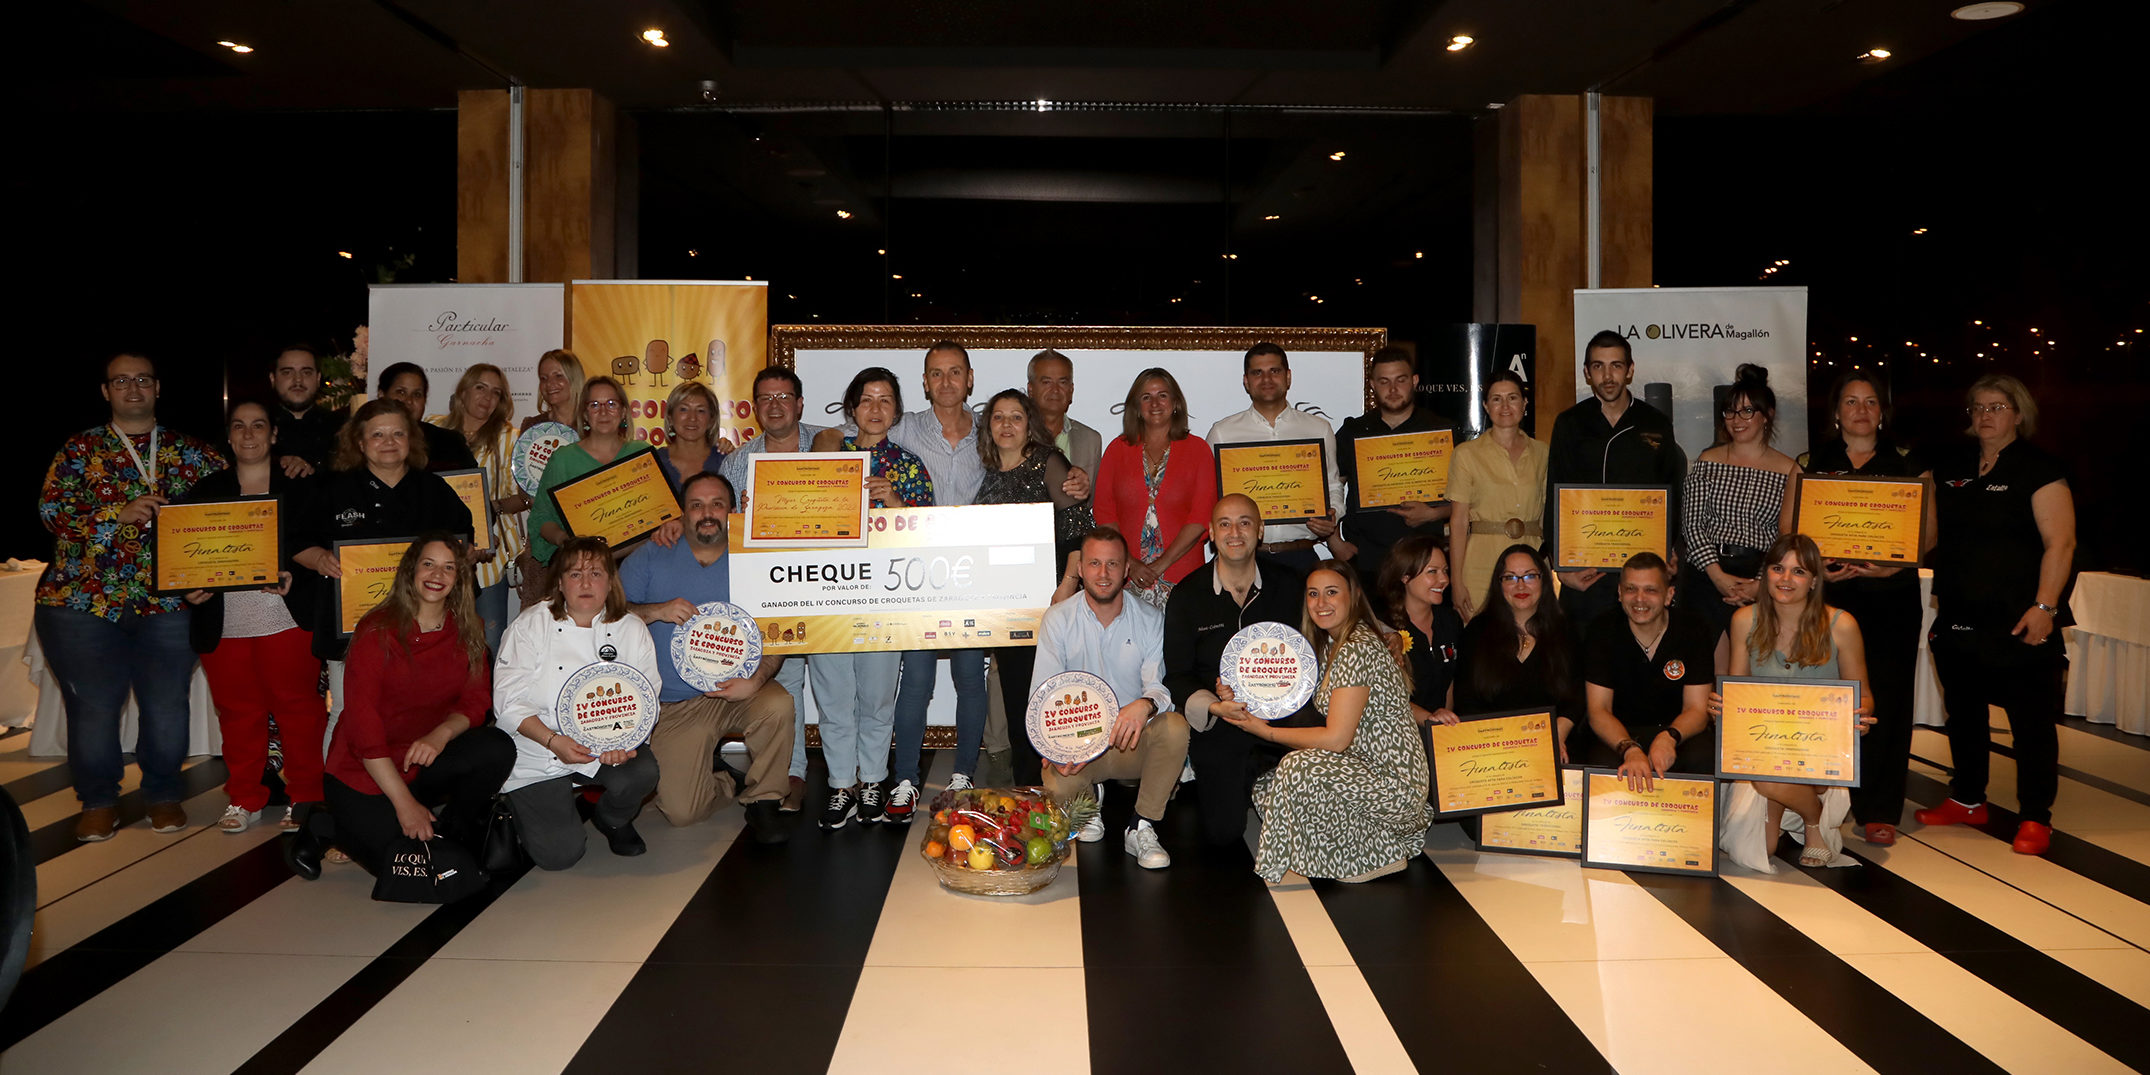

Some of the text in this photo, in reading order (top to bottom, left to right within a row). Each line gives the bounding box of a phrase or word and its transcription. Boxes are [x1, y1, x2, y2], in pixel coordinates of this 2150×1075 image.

[428, 311, 510, 332] Particular
[1618, 324, 1640, 340] LA
[1645, 323, 1725, 340] OLIVERA
[1725, 329, 1770, 340] Magallón
[436, 334, 495, 350] Garnacha
[1425, 384, 1444, 394] QUE
[1447, 384, 1468, 392] VES,
[1376, 466, 1436, 481] Finalista
[1243, 479, 1302, 494] Finalista
[335, 512, 365, 520] FLASH
[590, 494, 649, 523] Finalista
[894, 515, 918, 532] DE
[1823, 515, 1893, 530] Finalista
[1581, 523, 1645, 539] Finalista
[183, 541, 255, 558] Finalista
[769, 563, 872, 584] CHEQUE
[884, 554, 974, 591] 500€
[825, 598, 867, 606] CONCURSO
[880, 596, 925, 604] CROQUETAS
[691, 630, 744, 646] IV CONCURSO
[701, 641, 744, 655] CROQUETAS
[576, 695, 634, 711] IV CONCURSO
[1045, 703, 1099, 719] IV CONCURSO
[577, 703, 637, 720] DE CROQUETAS
[1045, 711, 1102, 727] DE CROQUETAS
[1748, 724, 1824, 742] Finalista
[1459, 759, 1529, 777] Finalista
[1661, 802, 1699, 811] CROQUETAS
[1614, 815, 1688, 833] Finalista
